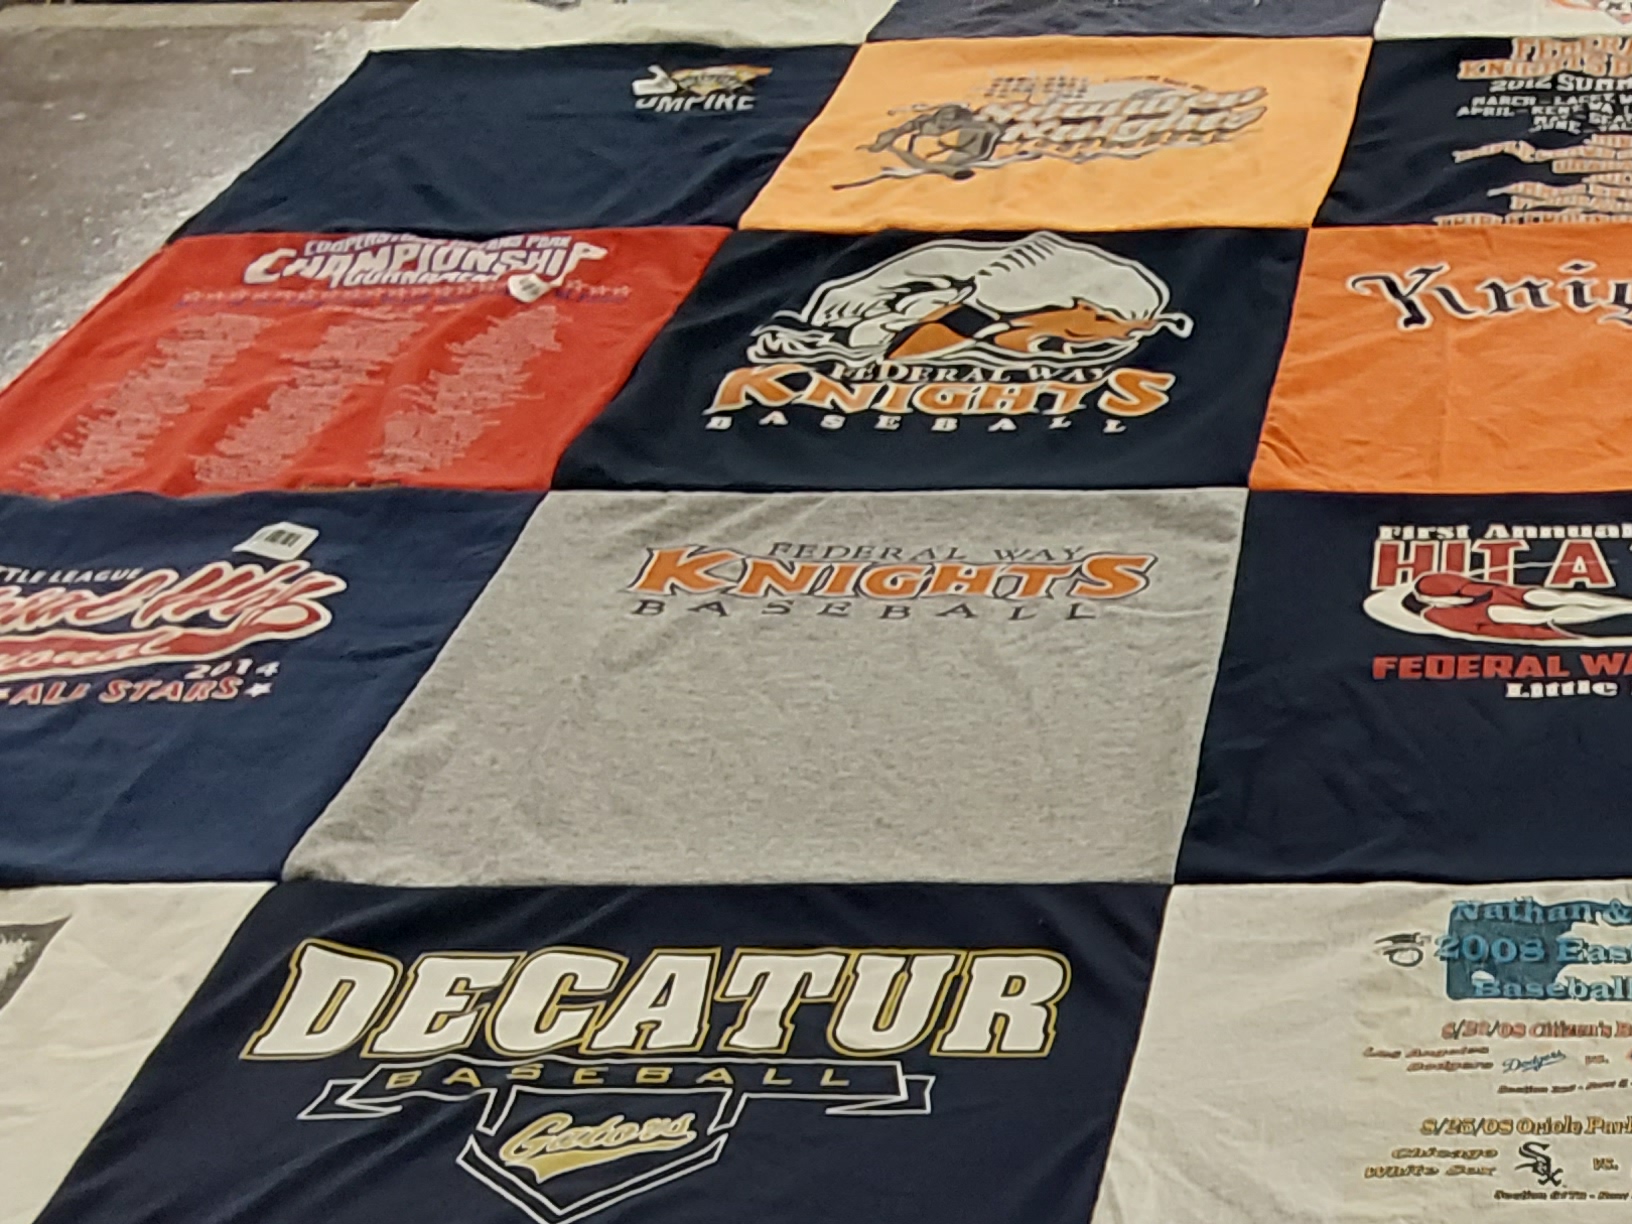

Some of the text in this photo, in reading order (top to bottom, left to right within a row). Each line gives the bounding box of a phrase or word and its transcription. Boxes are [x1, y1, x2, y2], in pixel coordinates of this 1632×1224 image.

[1457, 54, 1606, 80] KNIGHTS
[1489, 77, 1552, 93] 2012
[243, 241, 609, 288] CHAMPIONSHIP
[831, 363, 1112, 384] FEDERAL WAY
[702, 362, 1178, 417] KNIGHTS
[705, 411, 1126, 433] BASEBALL
[1378, 525, 1470, 541] First
[768, 541, 1085, 562] FEDERAL WAY
[1369, 537, 1531, 590] HIT
[1544, 537, 1616, 588] A
[48, 567, 144, 584] LEAGUE
[626, 543, 1159, 601] KNIGHTS
[630, 598, 1098, 622] BASEBALL
[184, 658, 281, 680] 2014
[1371, 652, 1571, 681] FEDERAL
[8, 677, 244, 706] ALL STARS
[1505, 678, 1619, 699] Little
[1453, 896, 1601, 925] Nathan
[1434, 932, 1546, 964] 2008
[239, 938, 1072, 1060] DECATUR
[1502, 1049, 1567, 1075] Dodgers
[386, 1064, 852, 1089] BASEBALL
[497, 1111, 699, 1164] Gators
[1516, 1115, 1583, 1136] Oriole
